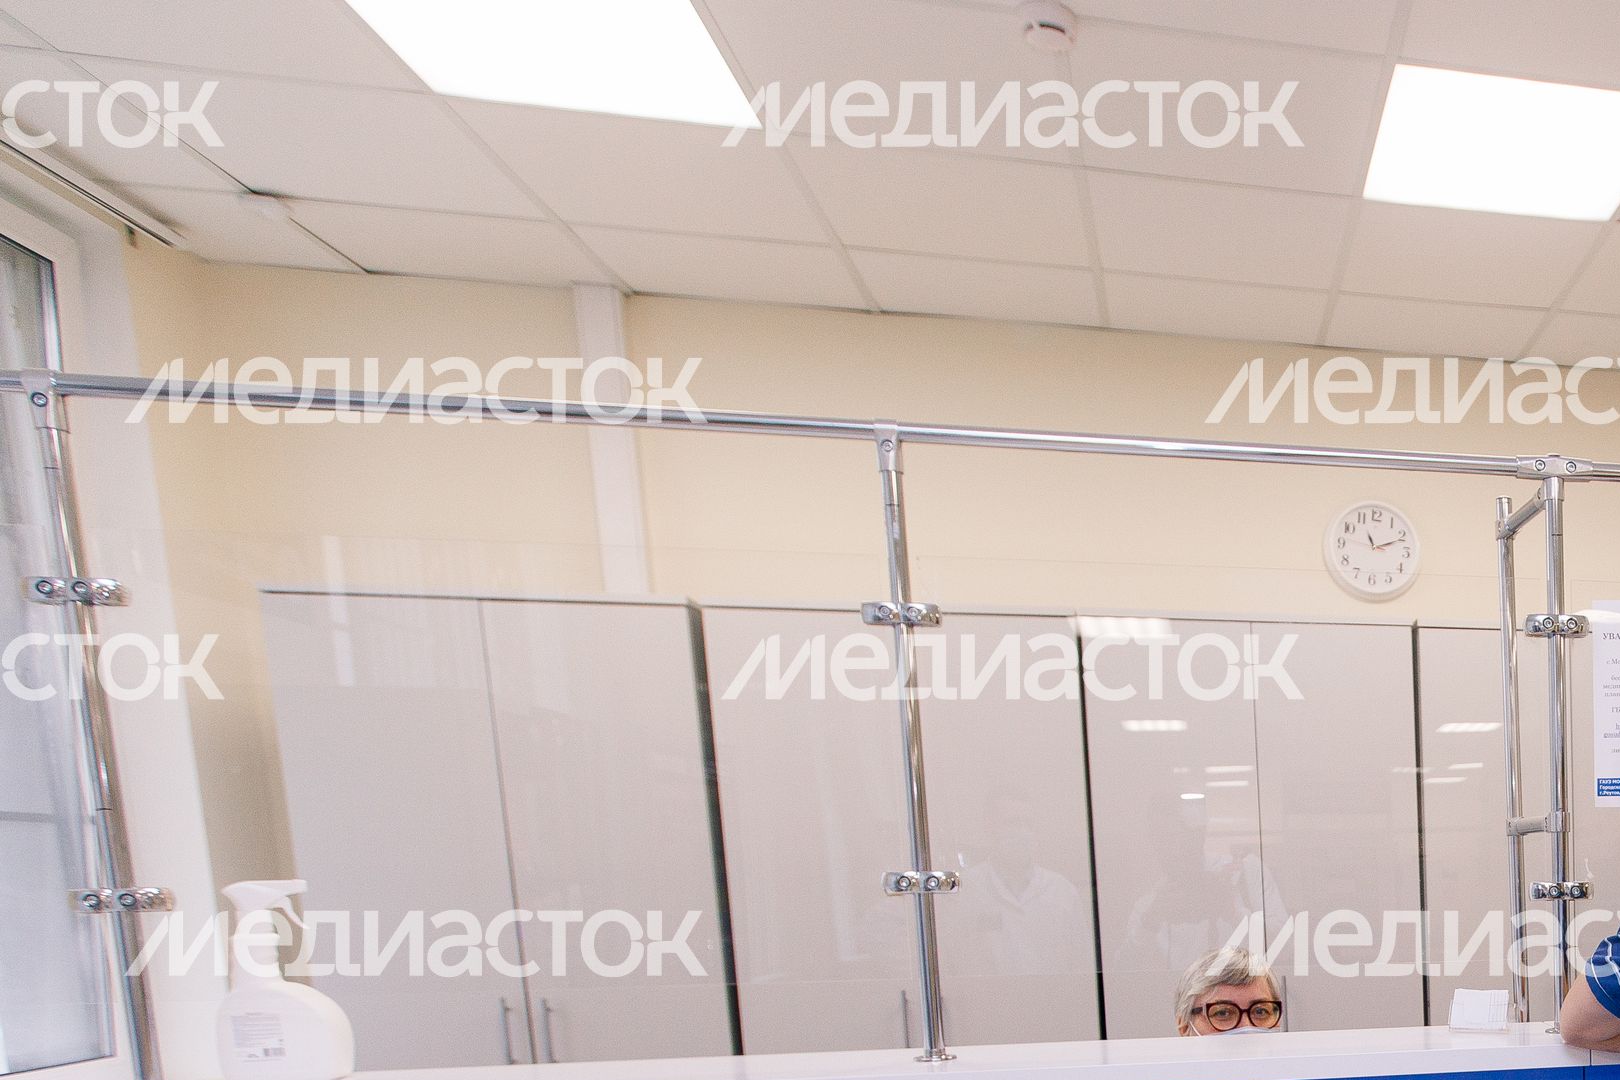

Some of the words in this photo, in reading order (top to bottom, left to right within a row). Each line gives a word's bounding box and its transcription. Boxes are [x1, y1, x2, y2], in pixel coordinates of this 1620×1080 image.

[1357, 511, 1366, 524] 11
[1372, 509, 1382, 522] 12
[1344, 521, 1355, 534] 10
[1338, 537, 1345, 549] 9
[1341, 554, 1349, 565] 8
[1353, 567, 1359, 579] 7
